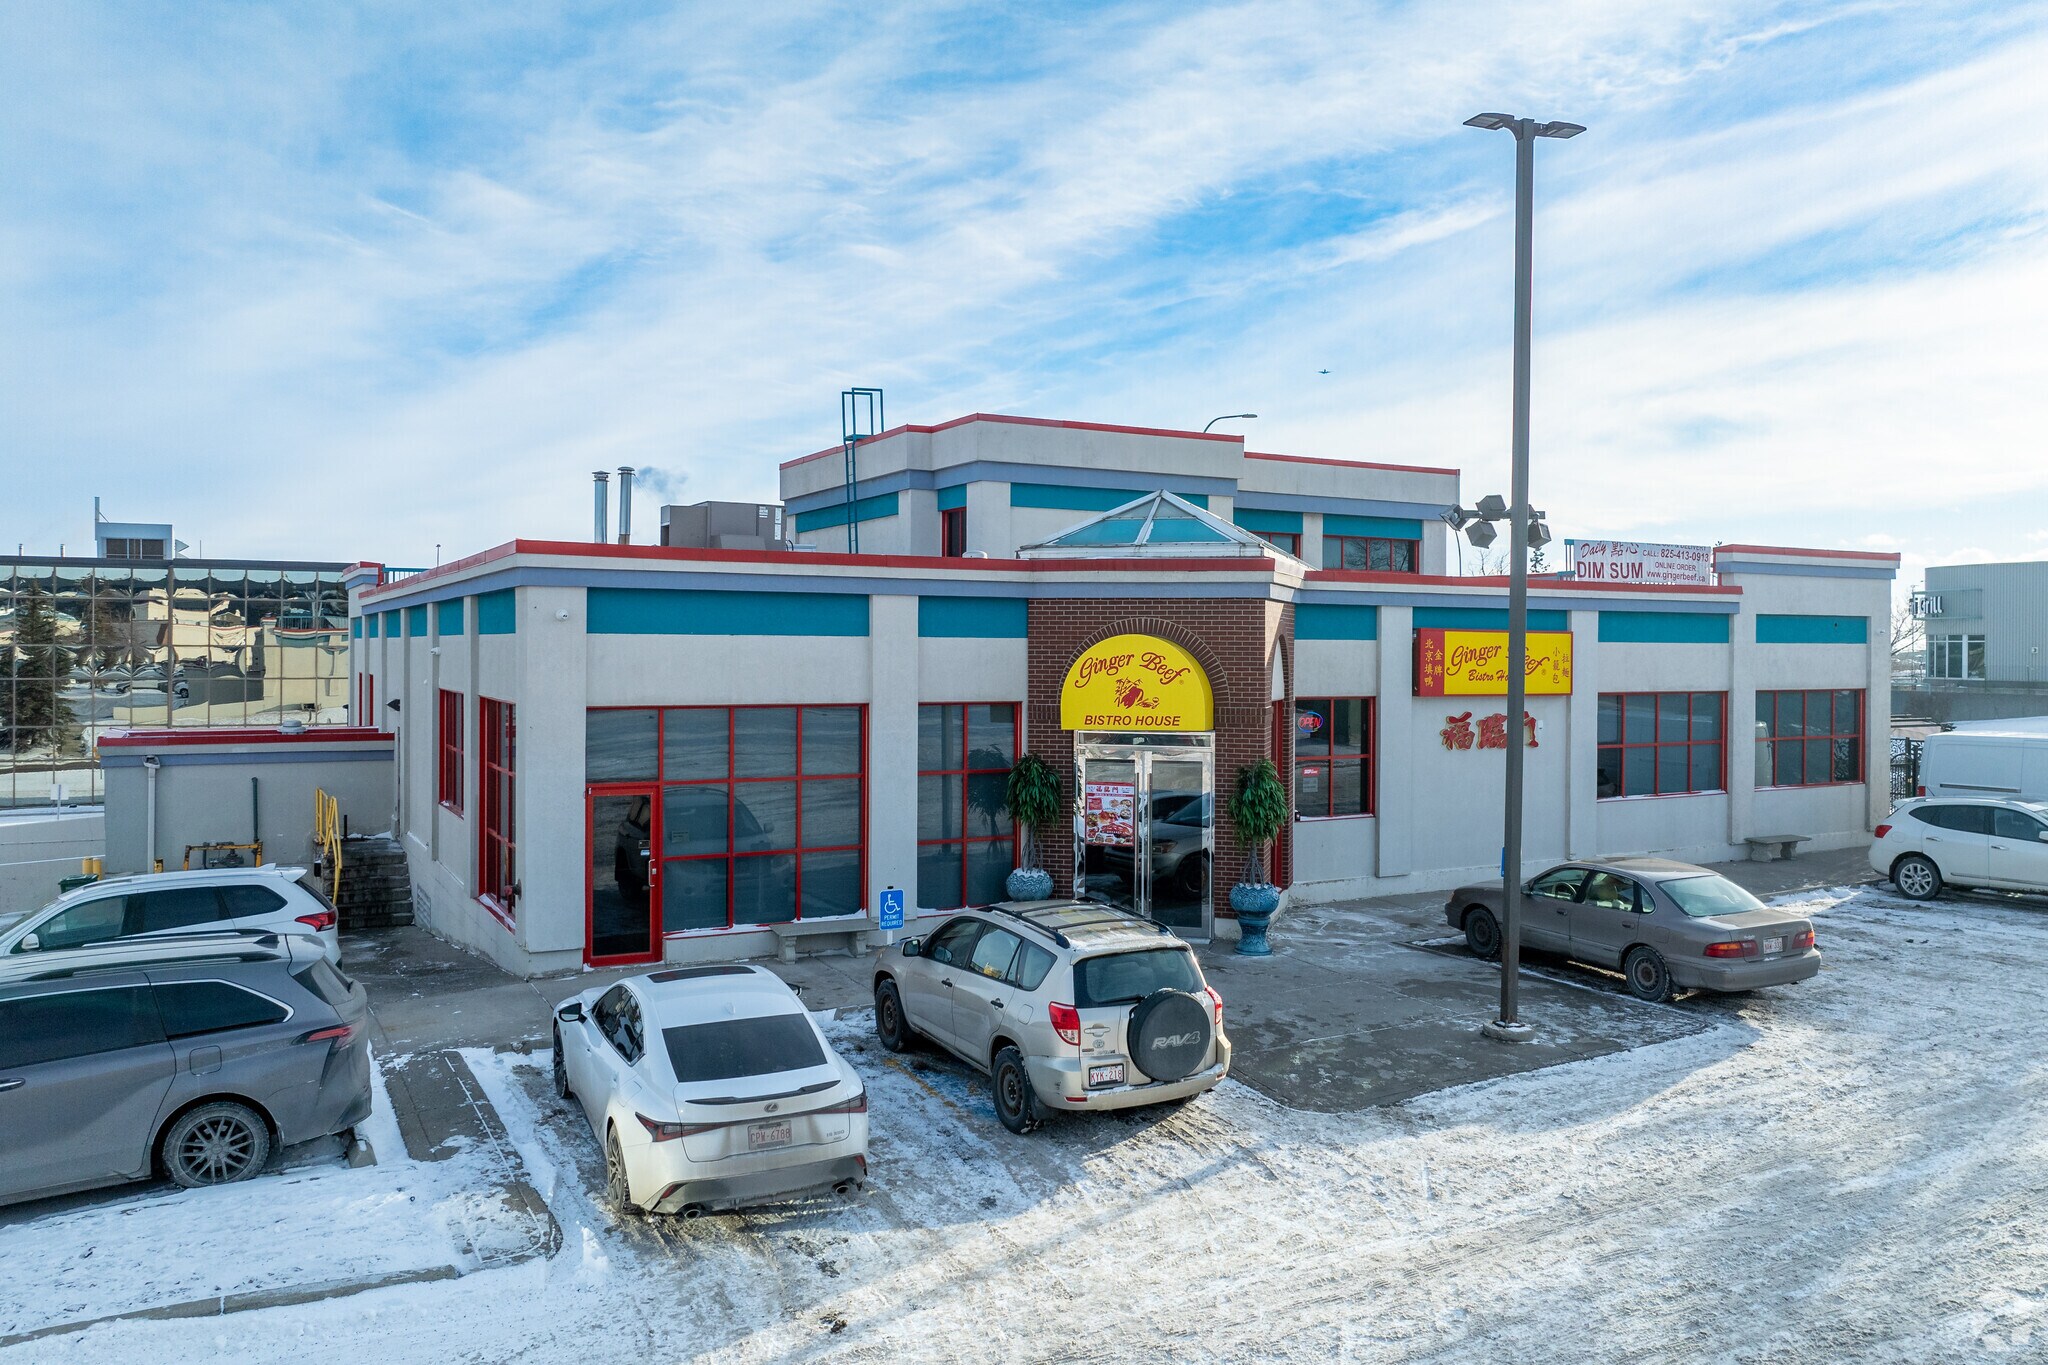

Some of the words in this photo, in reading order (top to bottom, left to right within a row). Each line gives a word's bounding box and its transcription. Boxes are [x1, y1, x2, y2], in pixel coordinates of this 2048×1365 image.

[1581, 540, 1607, 558] Daily
[1642, 549, 1659, 557] CALL:
[1660, 549, 1709, 562] 825-413-0913
[1577, 561, 1605, 579] DIM
[1610, 562, 1643, 579] SUM
[1655, 562, 1675, 570] ONLINE
[1676, 563, 1697, 571] ORDER
[1646, 571, 1706, 582] www.gingerbeef.ca
[1446, 645, 1502, 676] Ginger
[1505, 647, 1550, 676] eef
[1075, 653, 1135, 689] Ginger
[1139, 652, 1191, 685] Beef
[1468, 669, 1494, 682] Bistro
[1084, 714, 1132, 726] BISTRO
[1135, 715, 1181, 727] HOUSE
[1299, 717, 1321, 728] OPEN
[1151, 1030, 1201, 1050] RAV4
[1090, 1069, 1122, 1082] KYK-218
[750, 1128, 791, 1144] CPW-6788
